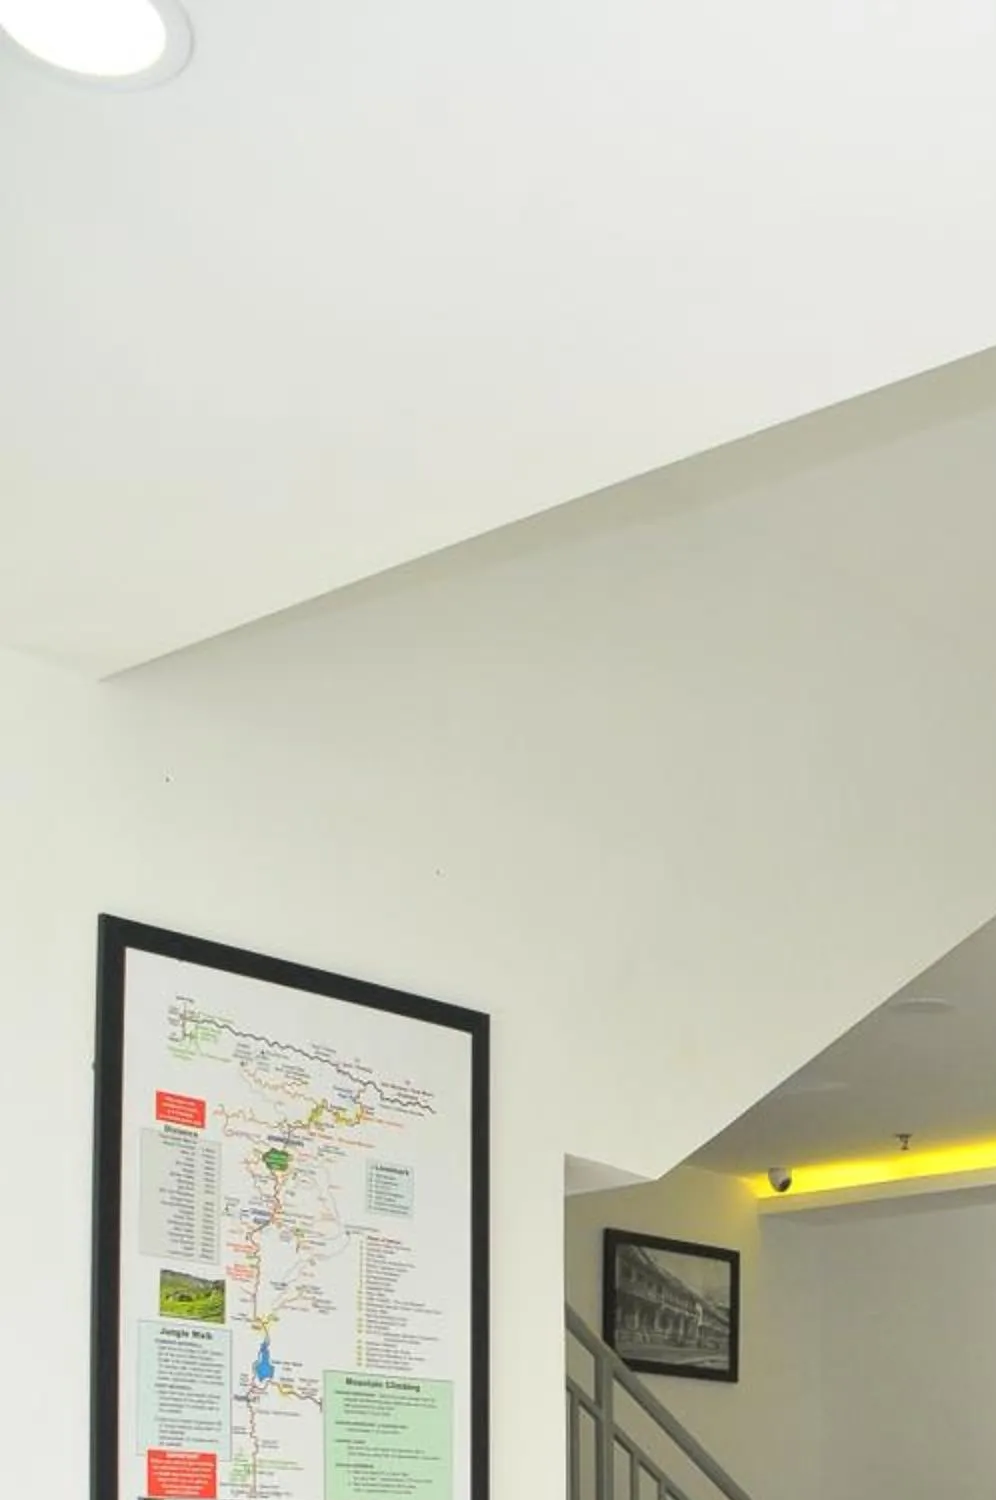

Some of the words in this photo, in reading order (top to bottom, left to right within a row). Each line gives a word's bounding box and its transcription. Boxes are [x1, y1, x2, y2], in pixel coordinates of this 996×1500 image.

[160, 1327, 190, 1339] Jungle
[191, 1330, 213, 1340] Walk
[345, 1377, 383, 1388] Mountain
[385, 1381, 421, 1393] Climbing
